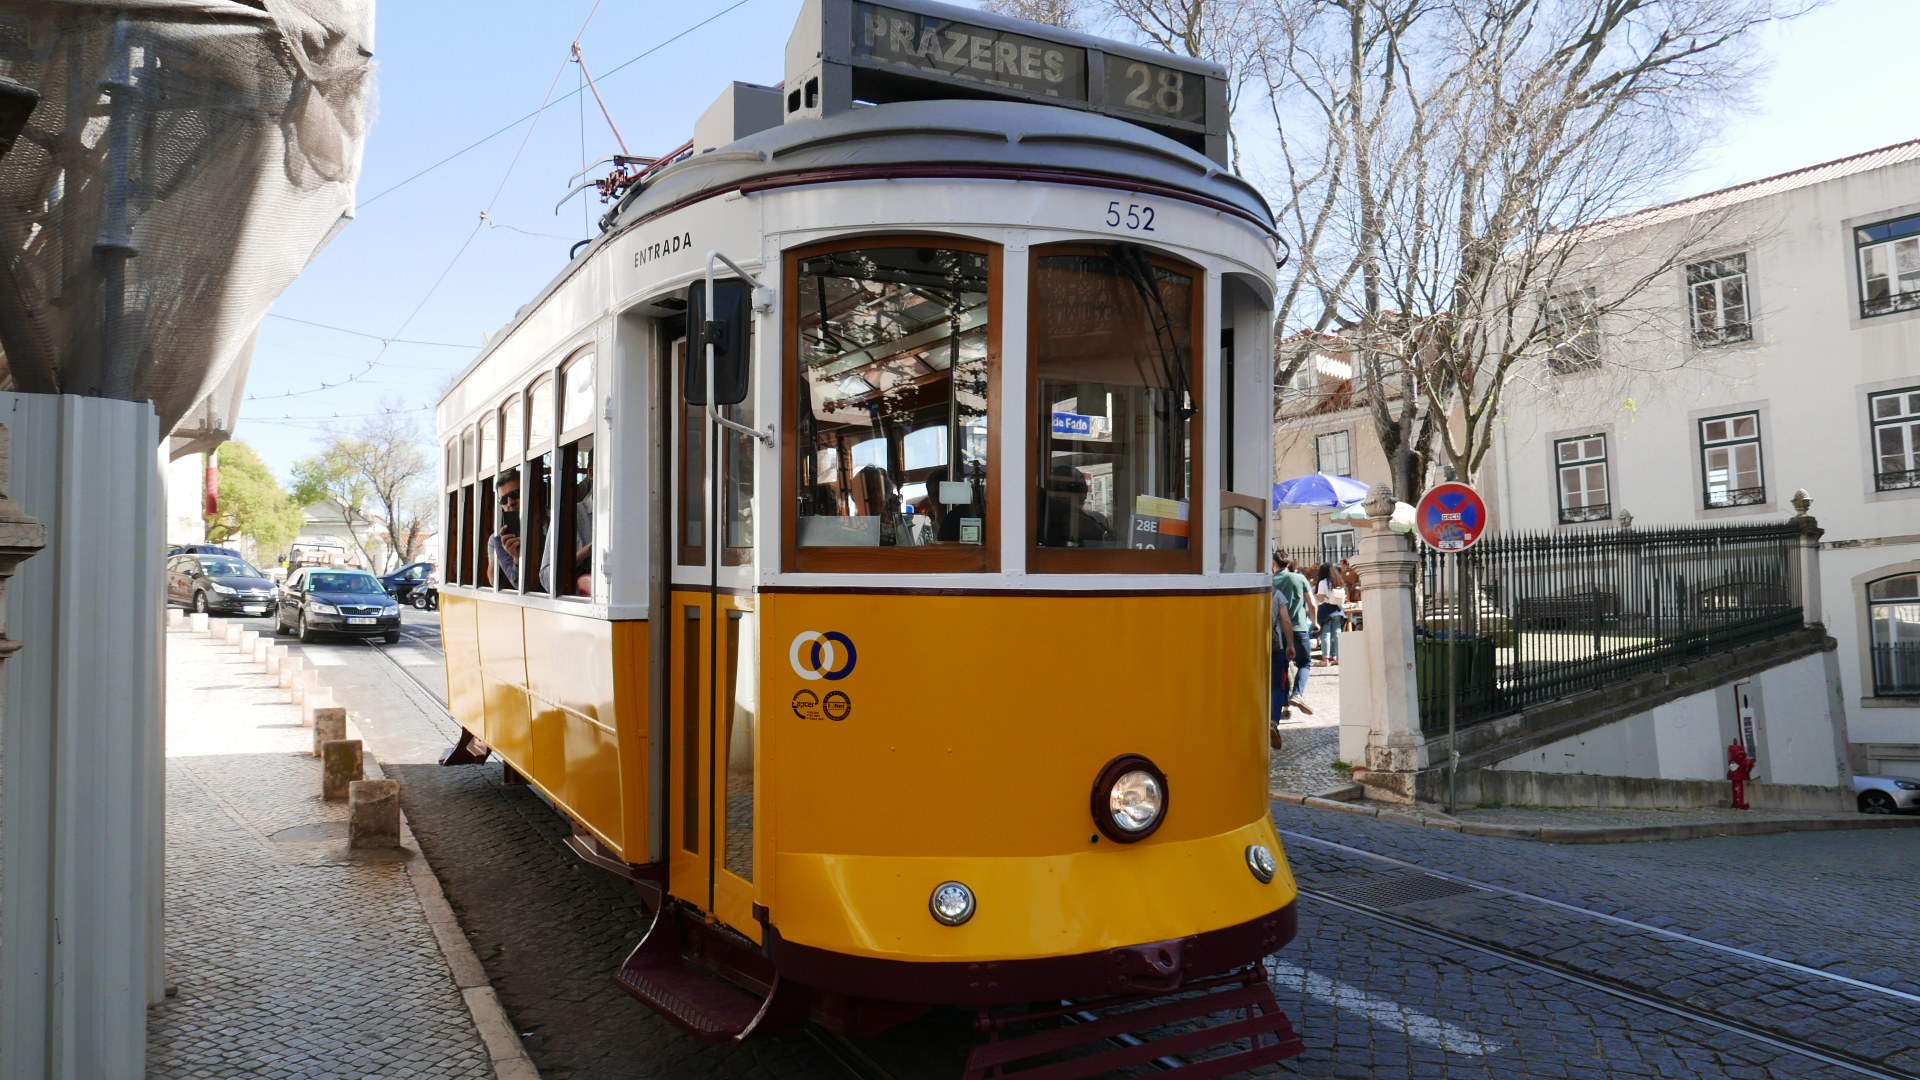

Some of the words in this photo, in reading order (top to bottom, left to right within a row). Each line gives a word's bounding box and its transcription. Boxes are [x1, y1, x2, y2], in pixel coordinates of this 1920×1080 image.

[864, 12, 1064, 83] PRAZERES
[1124, 62, 1184, 113] 28
[1106, 201, 1155, 231] 552
[634, 231, 692, 268] ENTRADA
[1065, 418, 1087, 430] Fado
[1136, 519, 1158, 533] 28E
